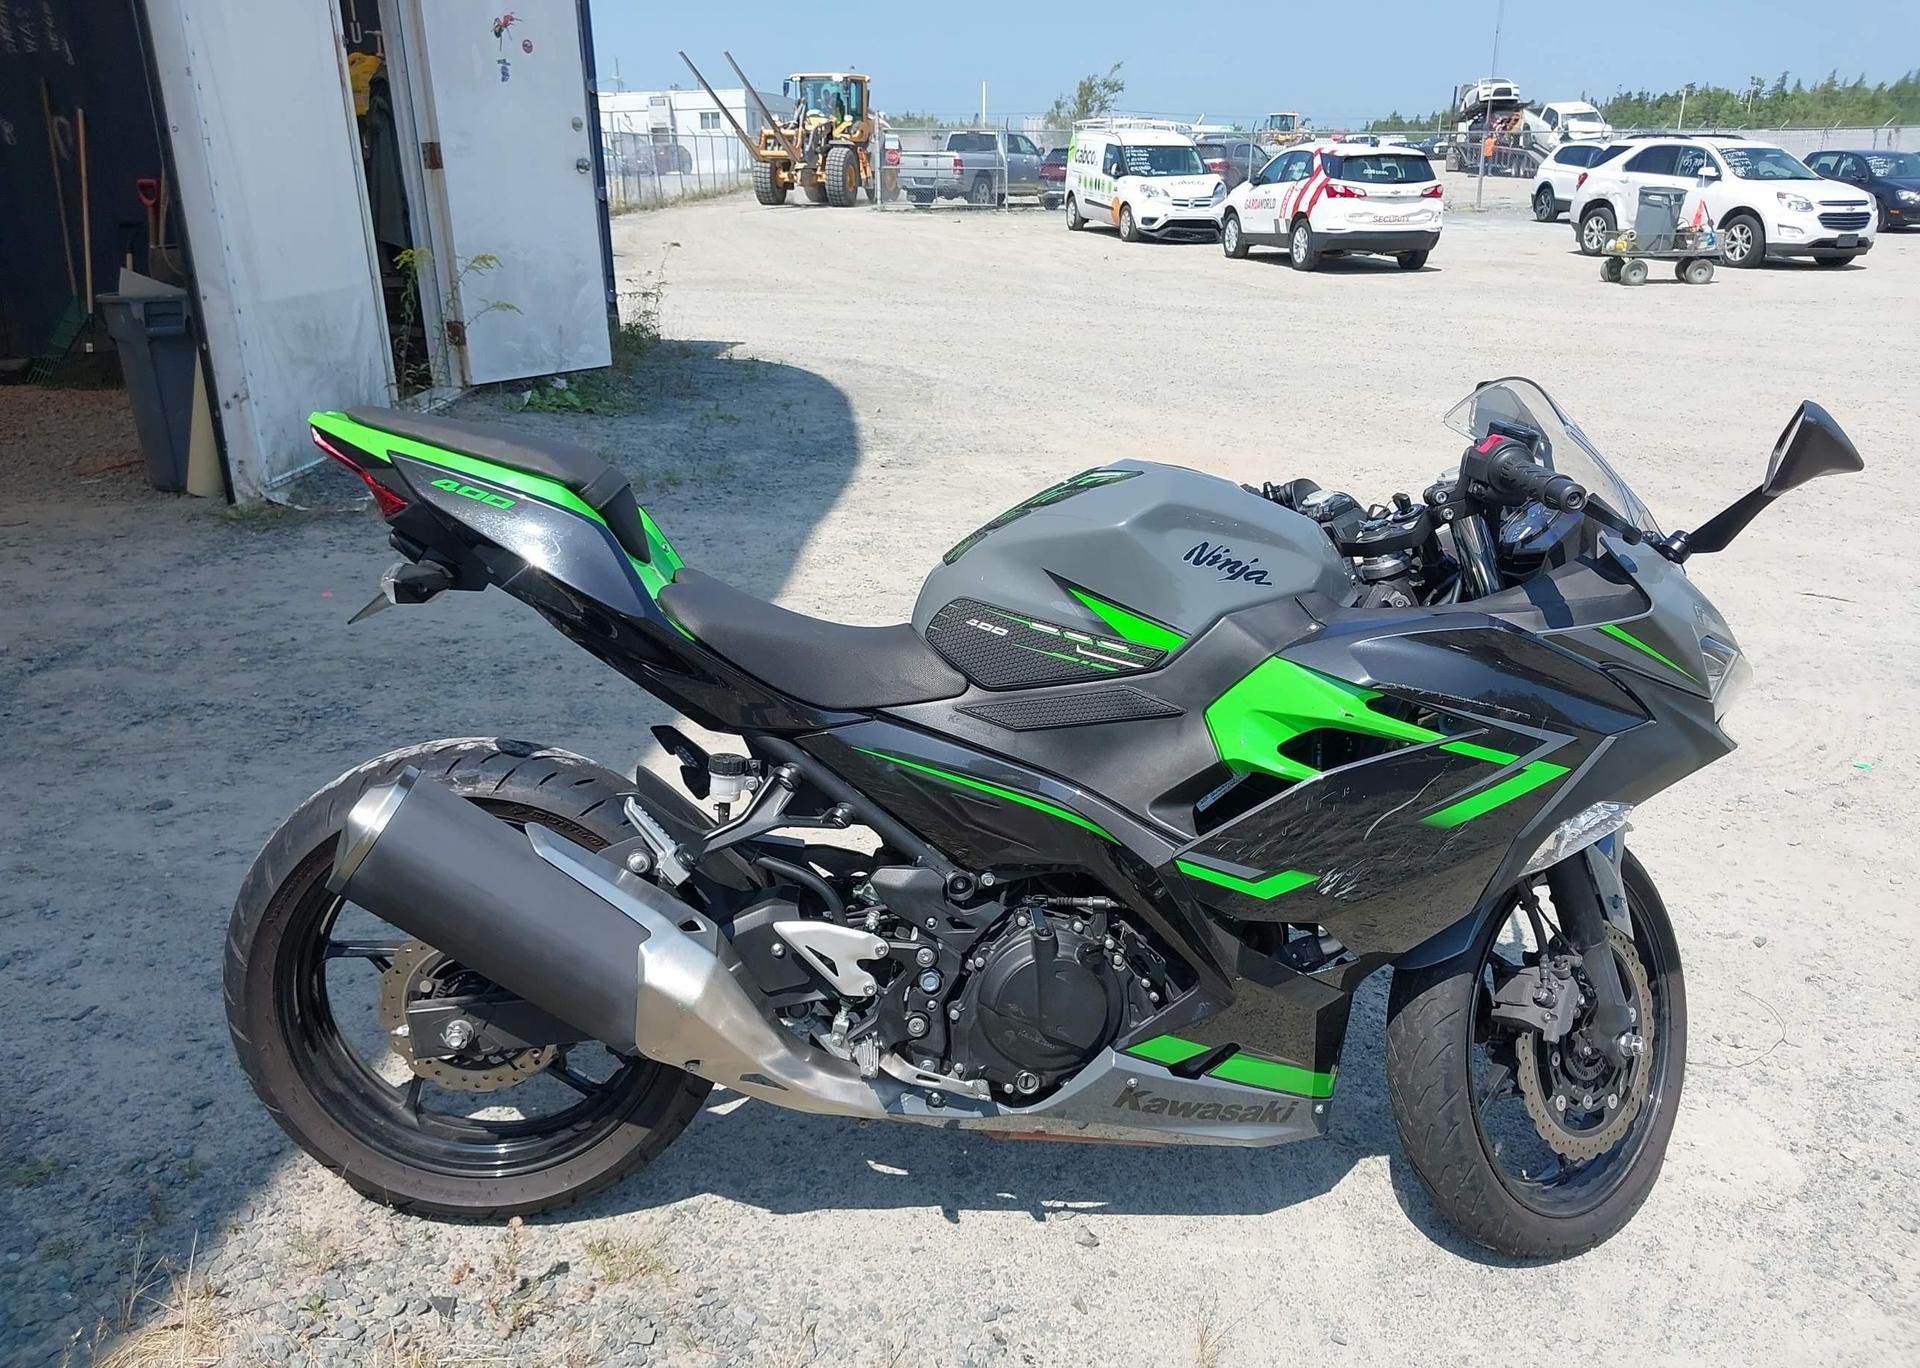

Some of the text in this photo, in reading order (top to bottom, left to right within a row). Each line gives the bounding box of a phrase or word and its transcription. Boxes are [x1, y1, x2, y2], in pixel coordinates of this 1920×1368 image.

[1372, 214, 1411, 223] SECURITY
[430, 478, 516, 510] 400
[1182, 540, 1273, 587] Ninja
[965, 618, 1009, 636] 400
[1112, 1084, 1300, 1124] Kawasaki
